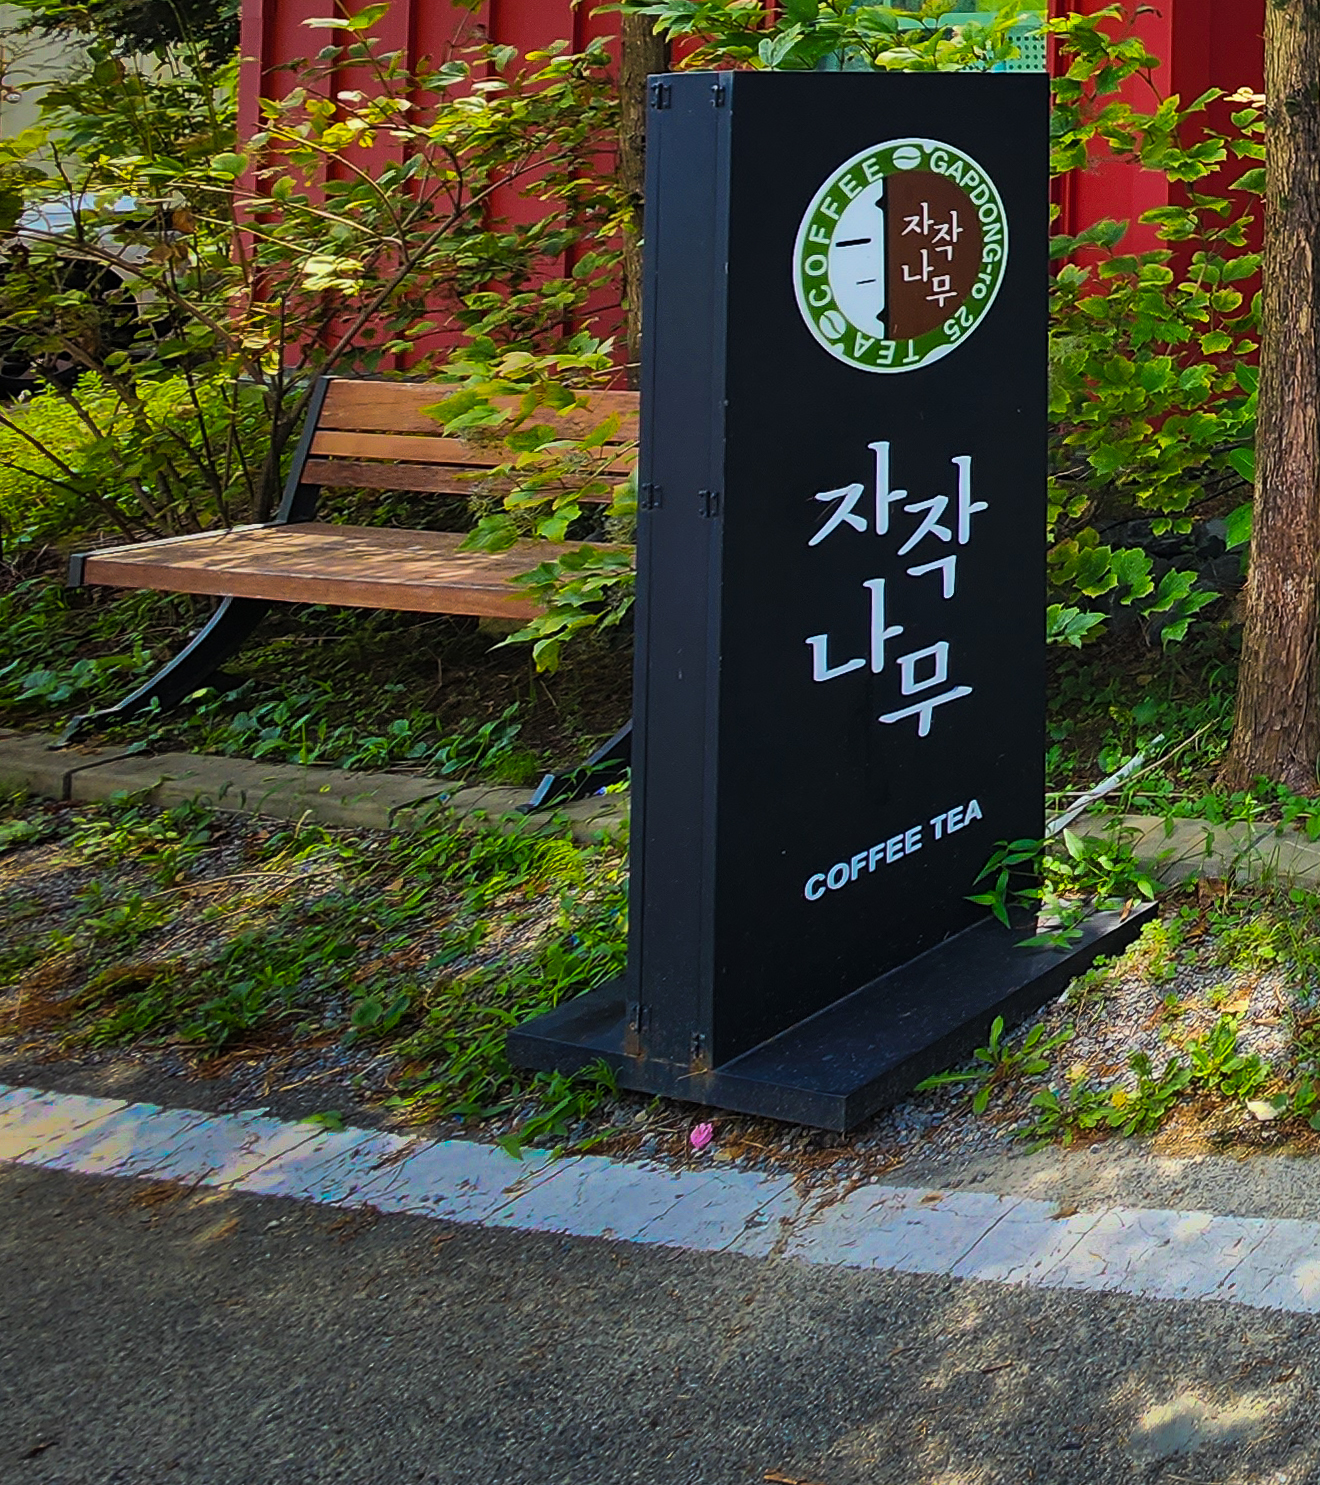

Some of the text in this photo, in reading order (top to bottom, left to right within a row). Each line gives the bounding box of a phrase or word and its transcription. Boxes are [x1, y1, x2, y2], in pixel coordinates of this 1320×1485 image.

[804, 157, 883, 307] COFFEE
[929, 150, 1002, 341] GAPDONG-ro 25
[853, 331, 920, 365] TEA
[808, 441, 988, 599] 자작
[805, 578, 973, 737] 나무
[804, 799, 983, 901] COFFEE TEA
